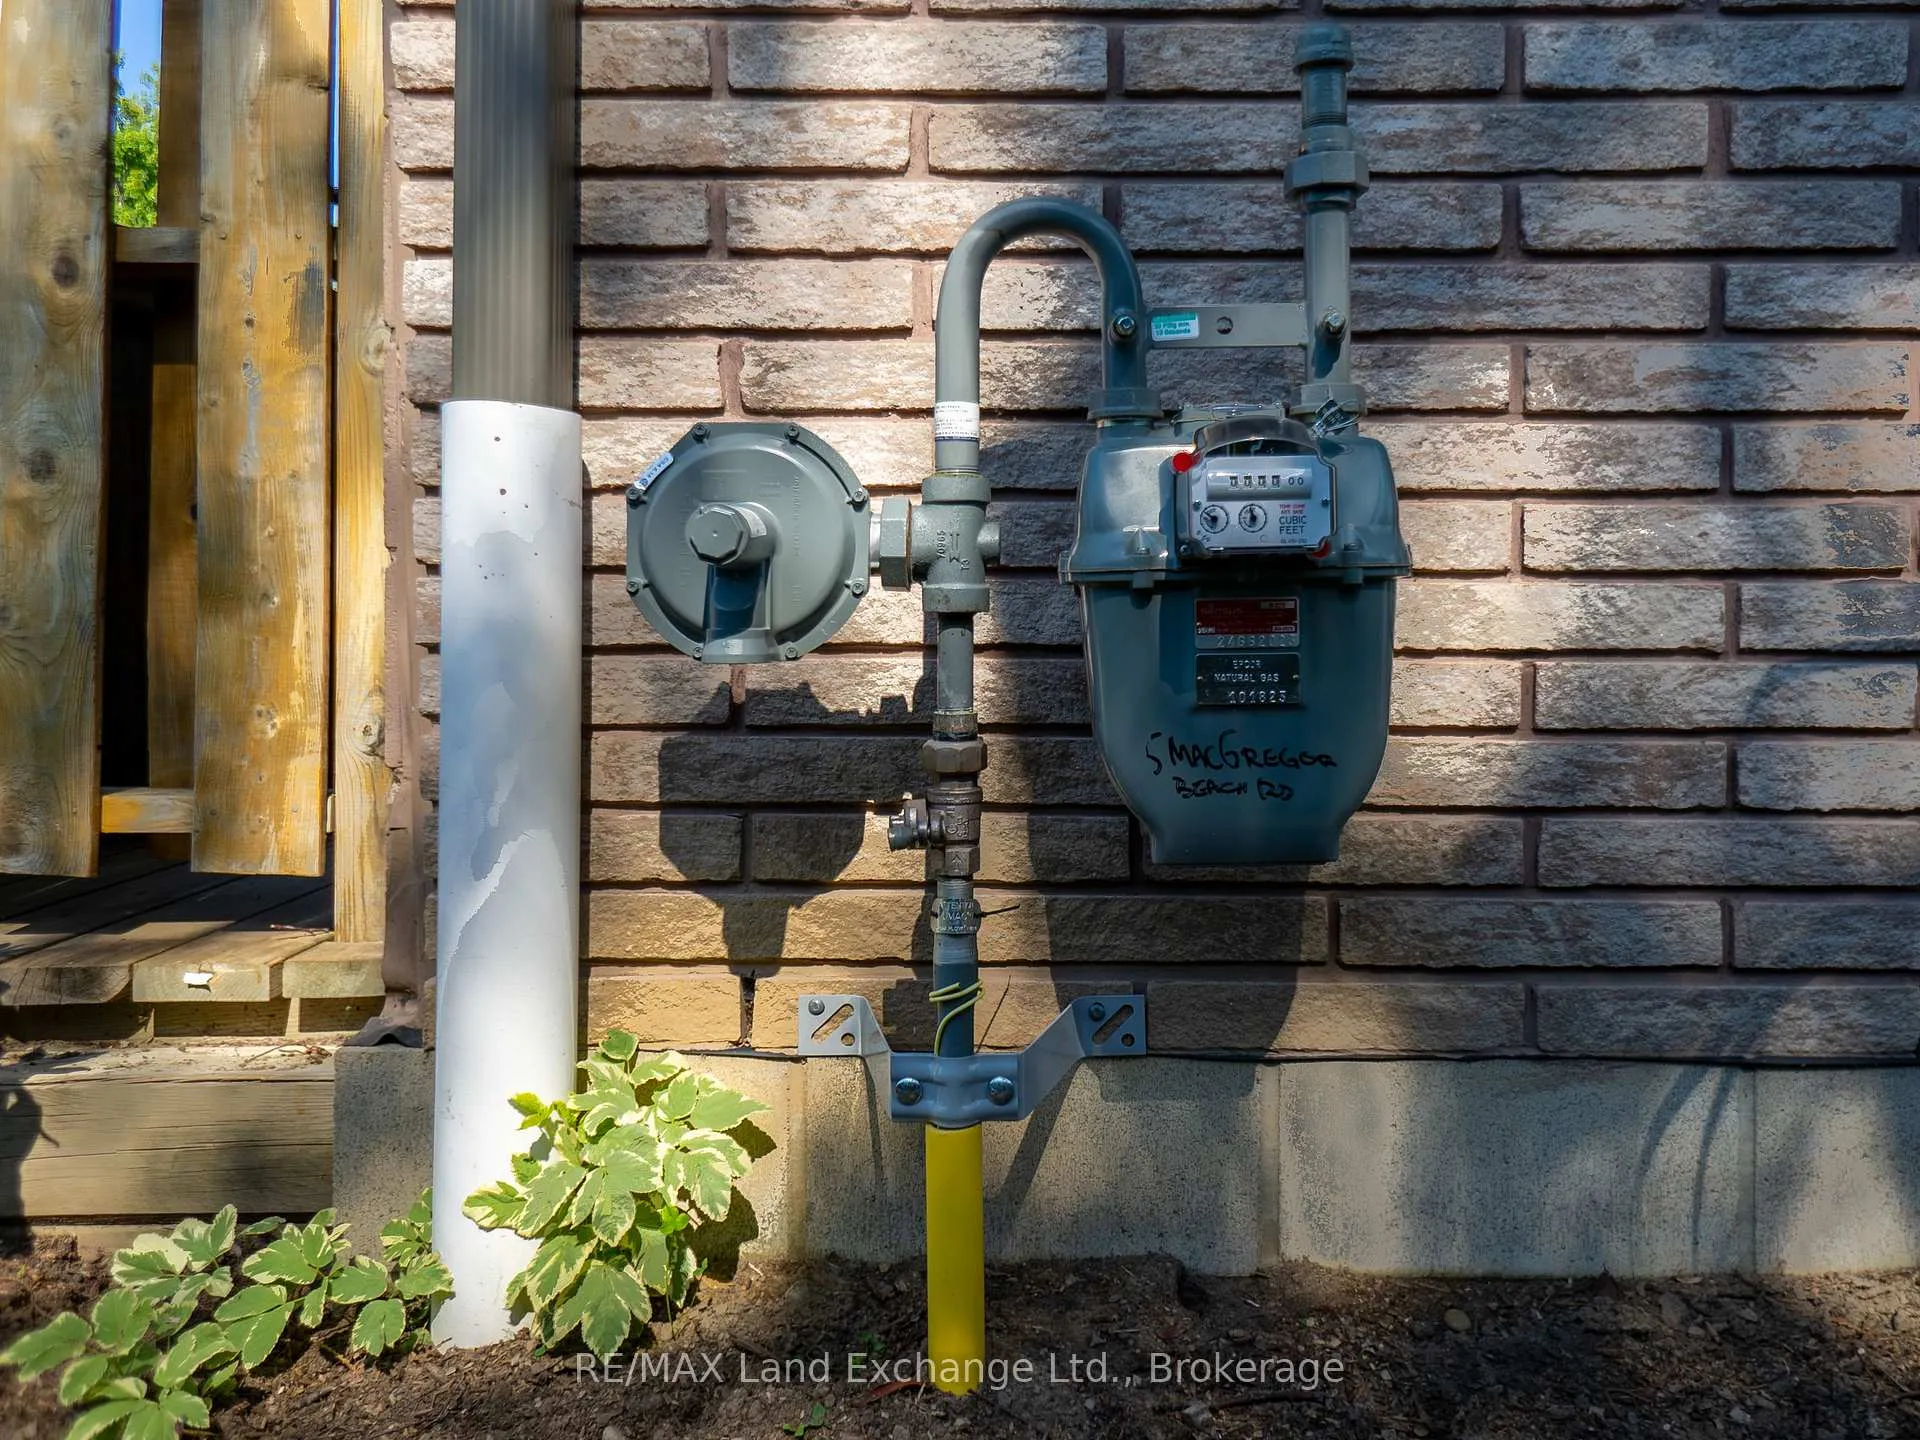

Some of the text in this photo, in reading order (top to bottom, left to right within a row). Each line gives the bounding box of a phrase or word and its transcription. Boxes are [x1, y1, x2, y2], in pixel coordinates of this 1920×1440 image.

[1279, 515, 1307, 526] CUBIC
[1279, 526, 1305, 535] FEET
[1214, 673, 1280, 682] NATURAL GAS
